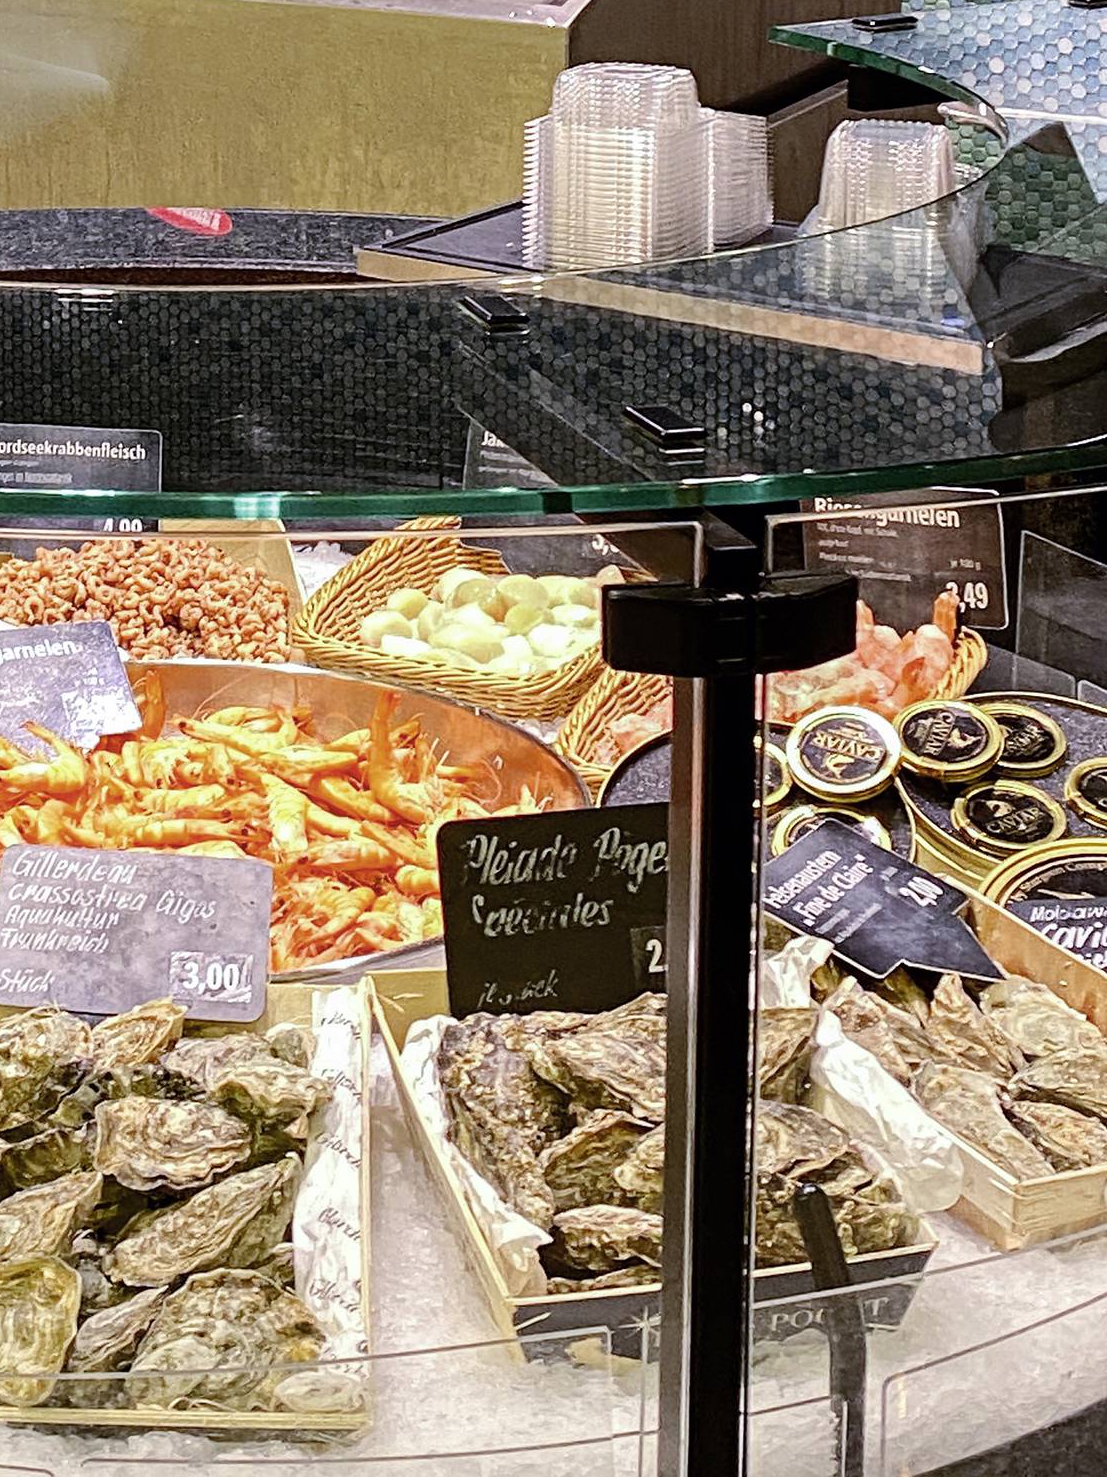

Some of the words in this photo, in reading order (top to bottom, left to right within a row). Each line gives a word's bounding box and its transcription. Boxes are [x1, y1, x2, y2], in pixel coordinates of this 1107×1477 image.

[812, 729, 886, 763] CAVIAR
[923, 711, 955, 756] CAVIAR
[986, 807, 1041, 833] CAVIAR
[5, 905, 120, 929] Aquakultur
[156, 890, 217, 924] Gigas
[182, 962, 240, 991] 3,00
